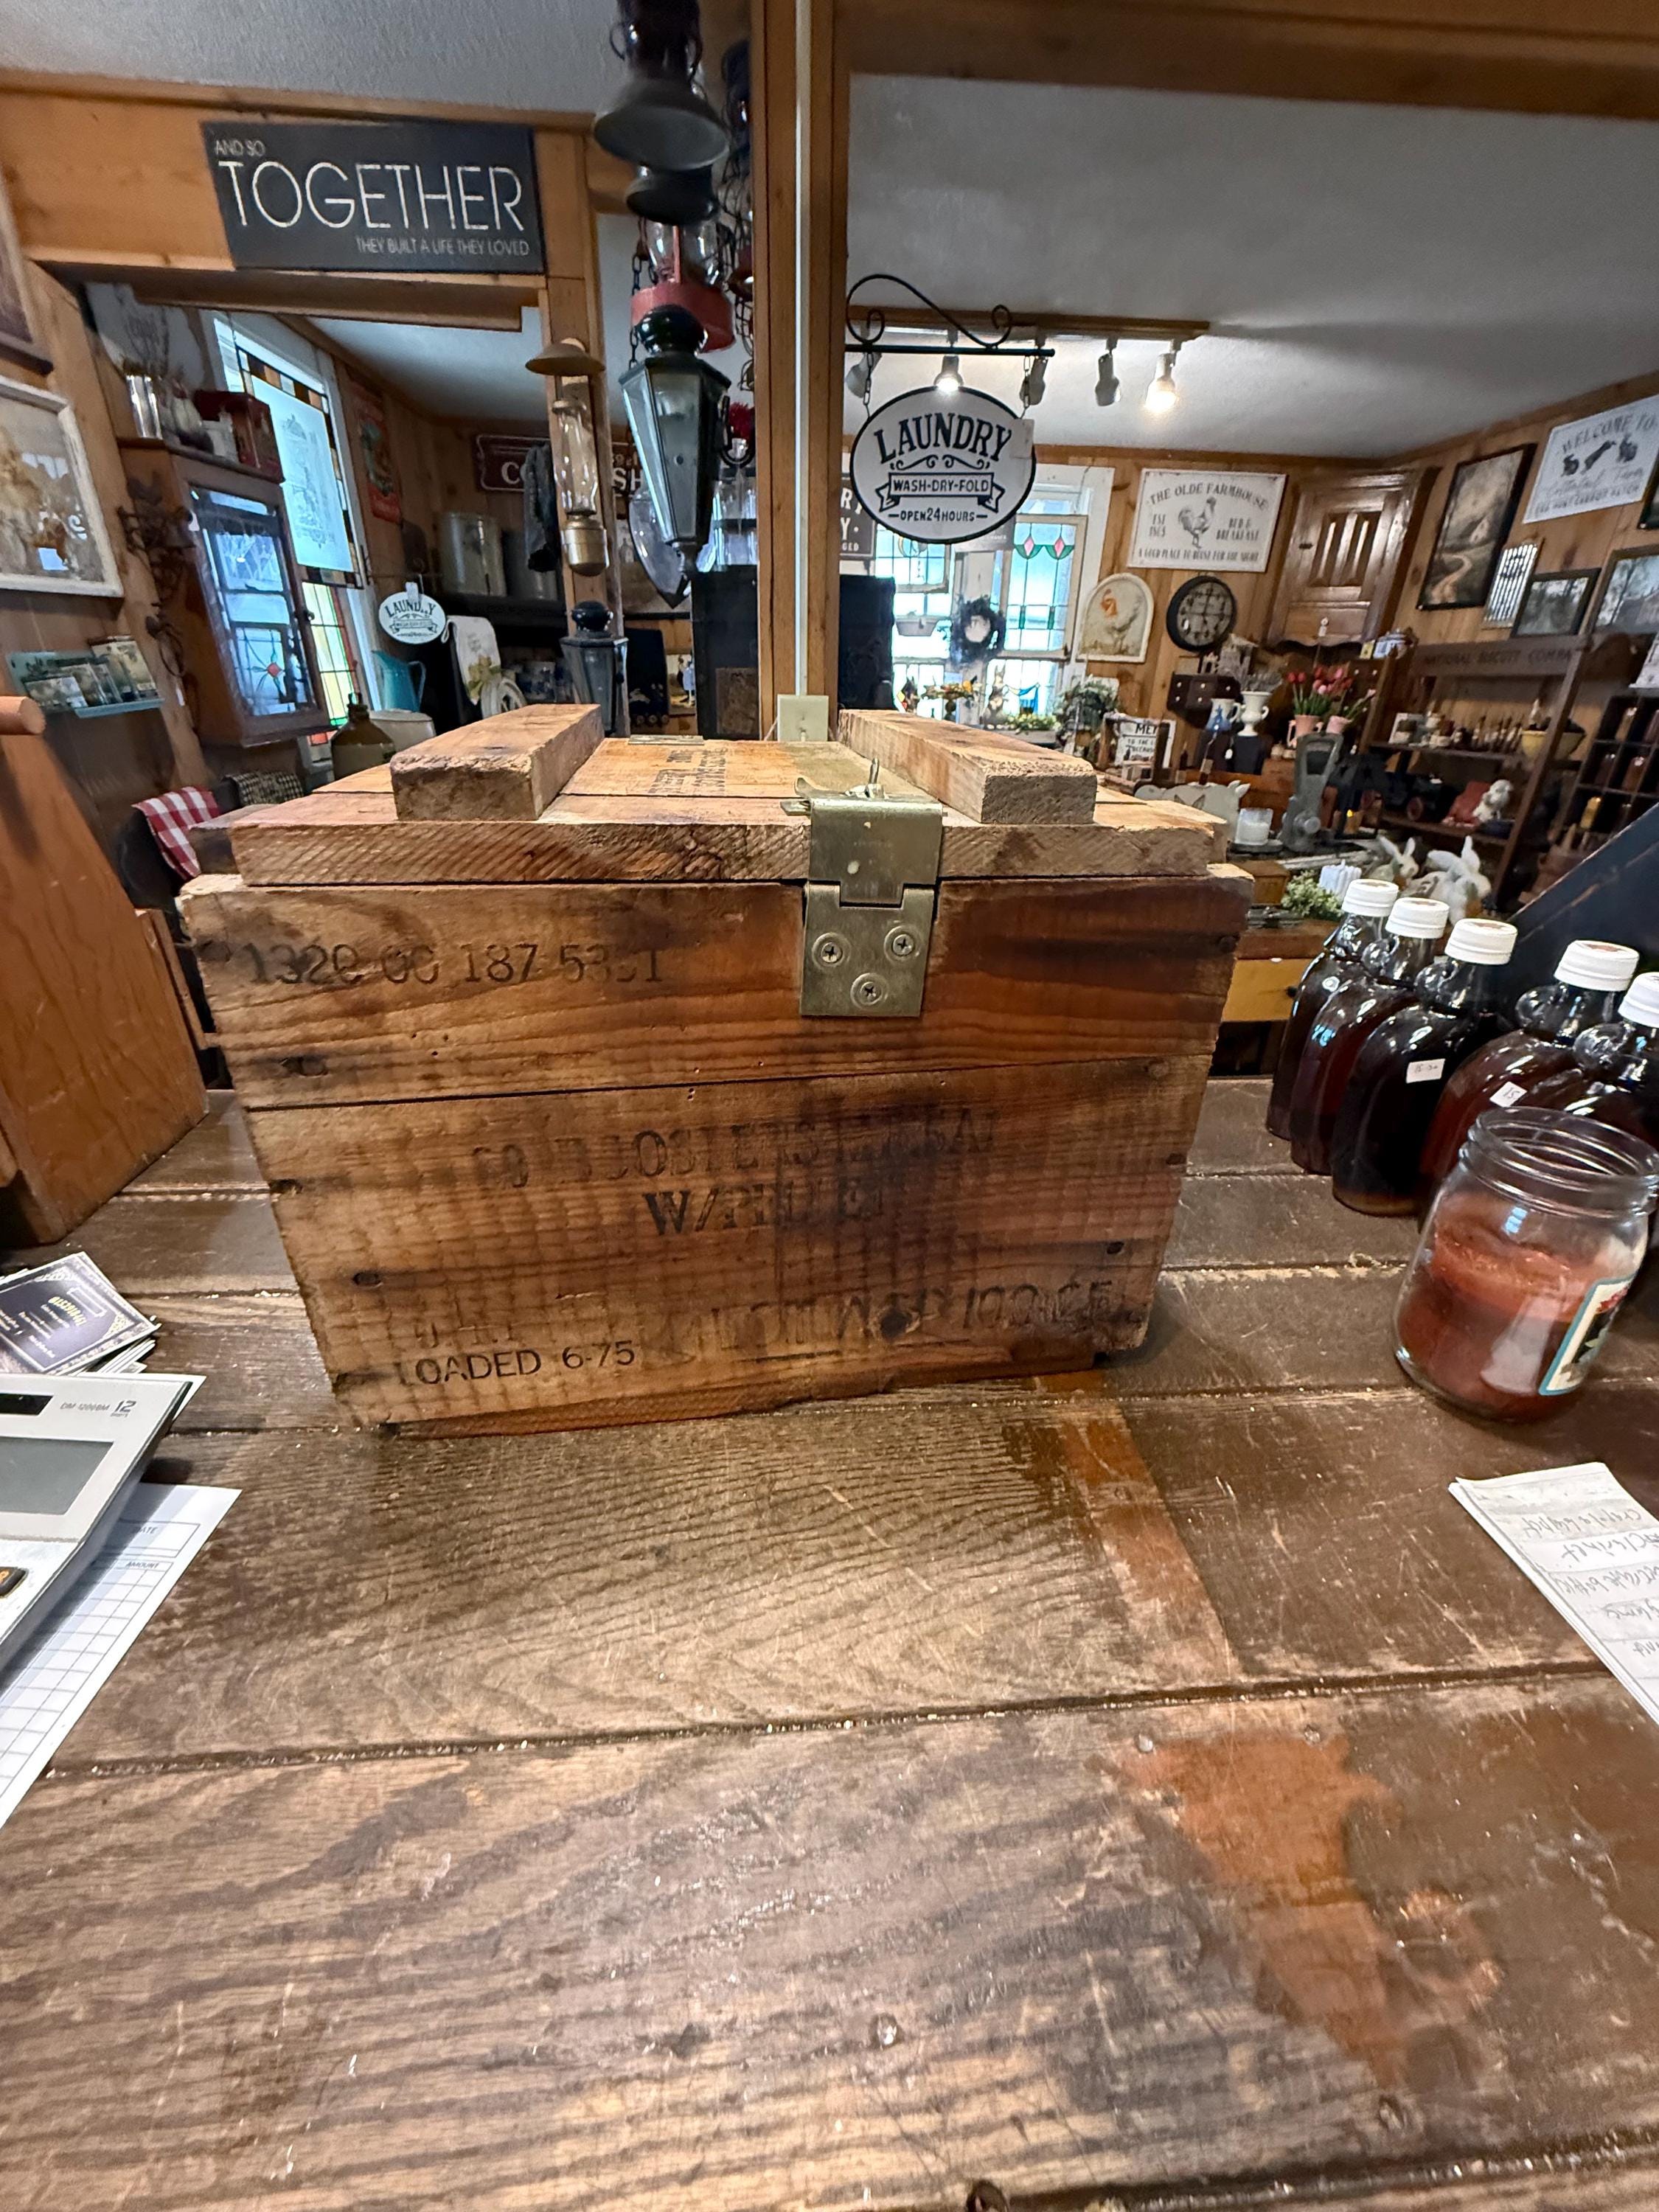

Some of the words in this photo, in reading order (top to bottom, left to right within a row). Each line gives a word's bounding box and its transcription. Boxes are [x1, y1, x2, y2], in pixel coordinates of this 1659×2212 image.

[214, 139, 244, 156] AND
[246, 140, 266, 156] SO
[218, 161, 524, 232] TOGETHER
[357, 237, 385, 253] THEY
[388, 238, 417, 254] BUILT
[420, 240, 428, 254] A
[431, 240, 454, 254] LIFE
[457, 240, 485, 255] THEY
[488, 240, 530, 256] LOVED
[874, 413, 1012, 464] LAUNDRY
[1150, 487, 1171, 505] THE
[1174, 482, 1203, 496] OLDE
[1206, 481, 1270, 511] FARMHOUSE
[900, 509, 926, 522] OPEN
[926, 507, 939, 519] 24
[942, 509, 975, 522] HOURS
[383, 599, 437, 618] LAUNDY
[460, 943, 539, 984] 187
[395, 1349, 542, 1386] LOADED
[114, 1399, 136, 1413] 12
